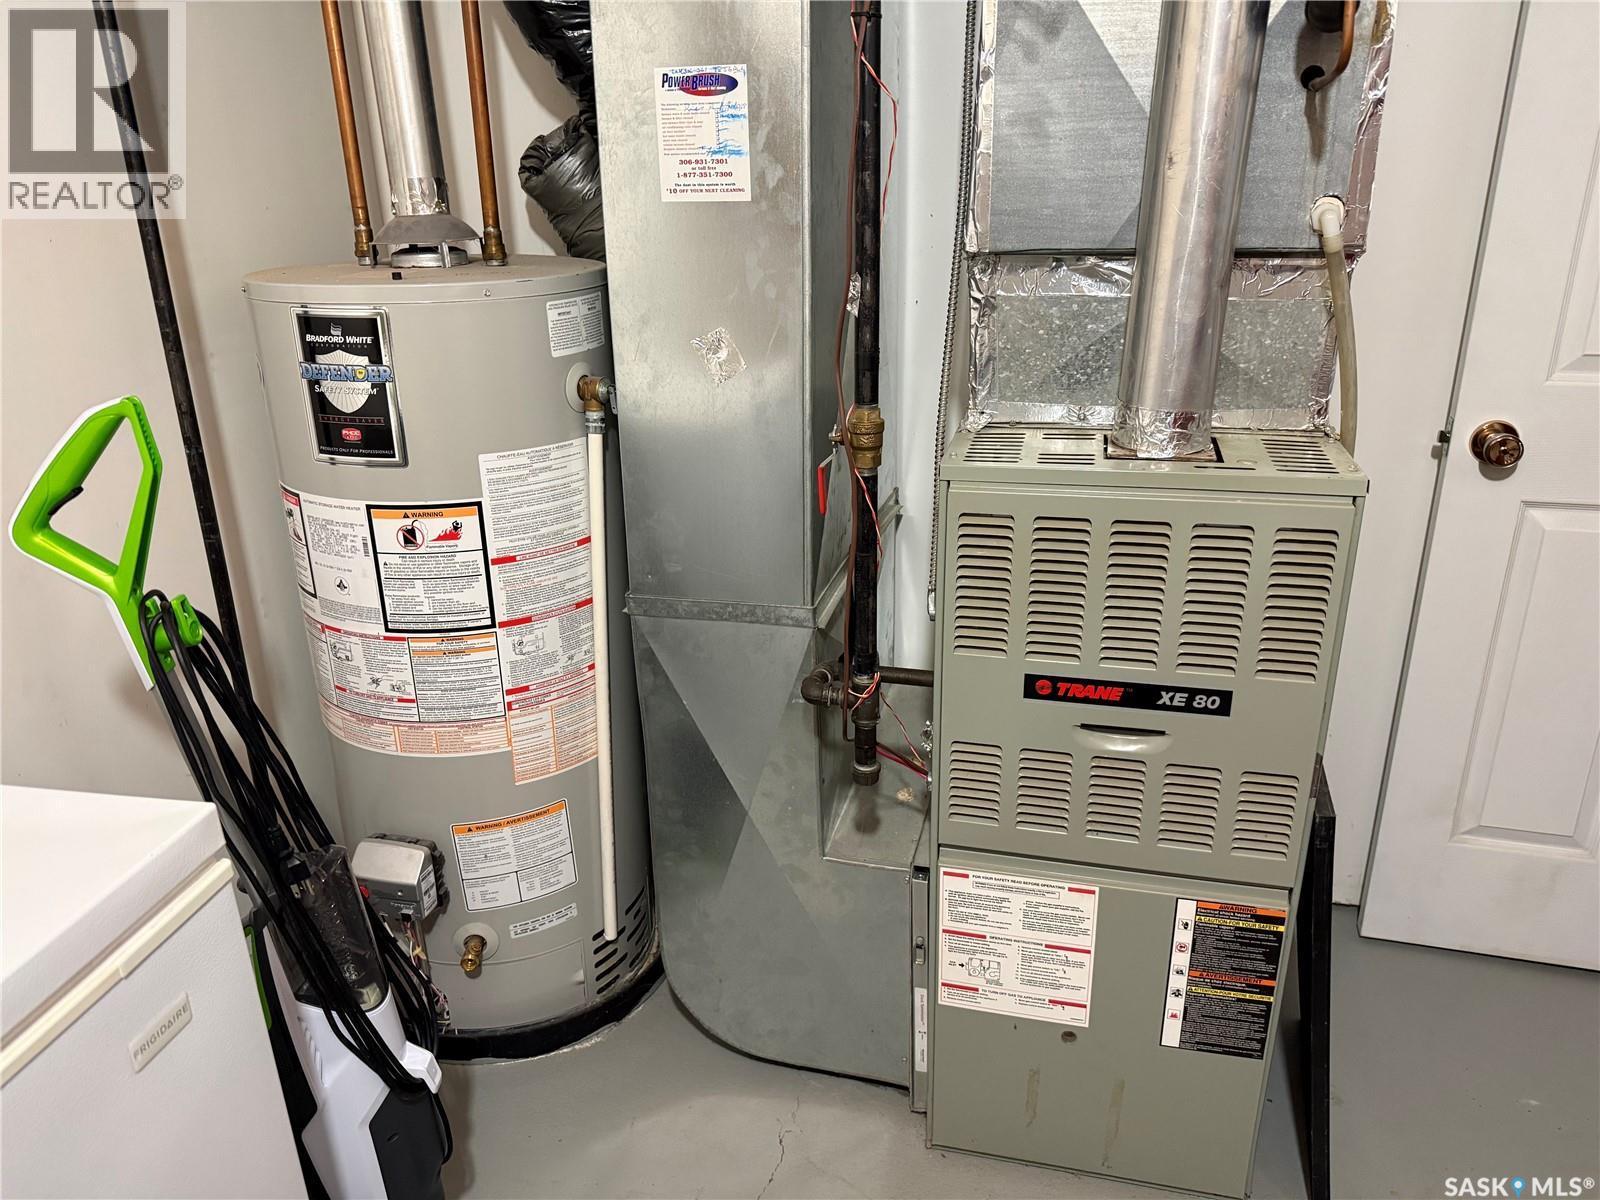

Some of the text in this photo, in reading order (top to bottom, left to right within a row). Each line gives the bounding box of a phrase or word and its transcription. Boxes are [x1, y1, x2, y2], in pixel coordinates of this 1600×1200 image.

[306, 334, 373, 344] BRADFORD WHITE
[300, 362, 393, 382] DEFENDER
[1056, 682, 1125, 701] TRANE
[1156, 691, 1221, 709] XE 80
[475, 822, 503, 831] WARNING
[506, 809, 551, 825] AVERTISSEMENT
[1225, 904, 1257, 913] WARNING
[1013, 938, 1043, 946] INSTRUCTIONS
[133, 1003, 189, 1060] FRIGIDAIRE
